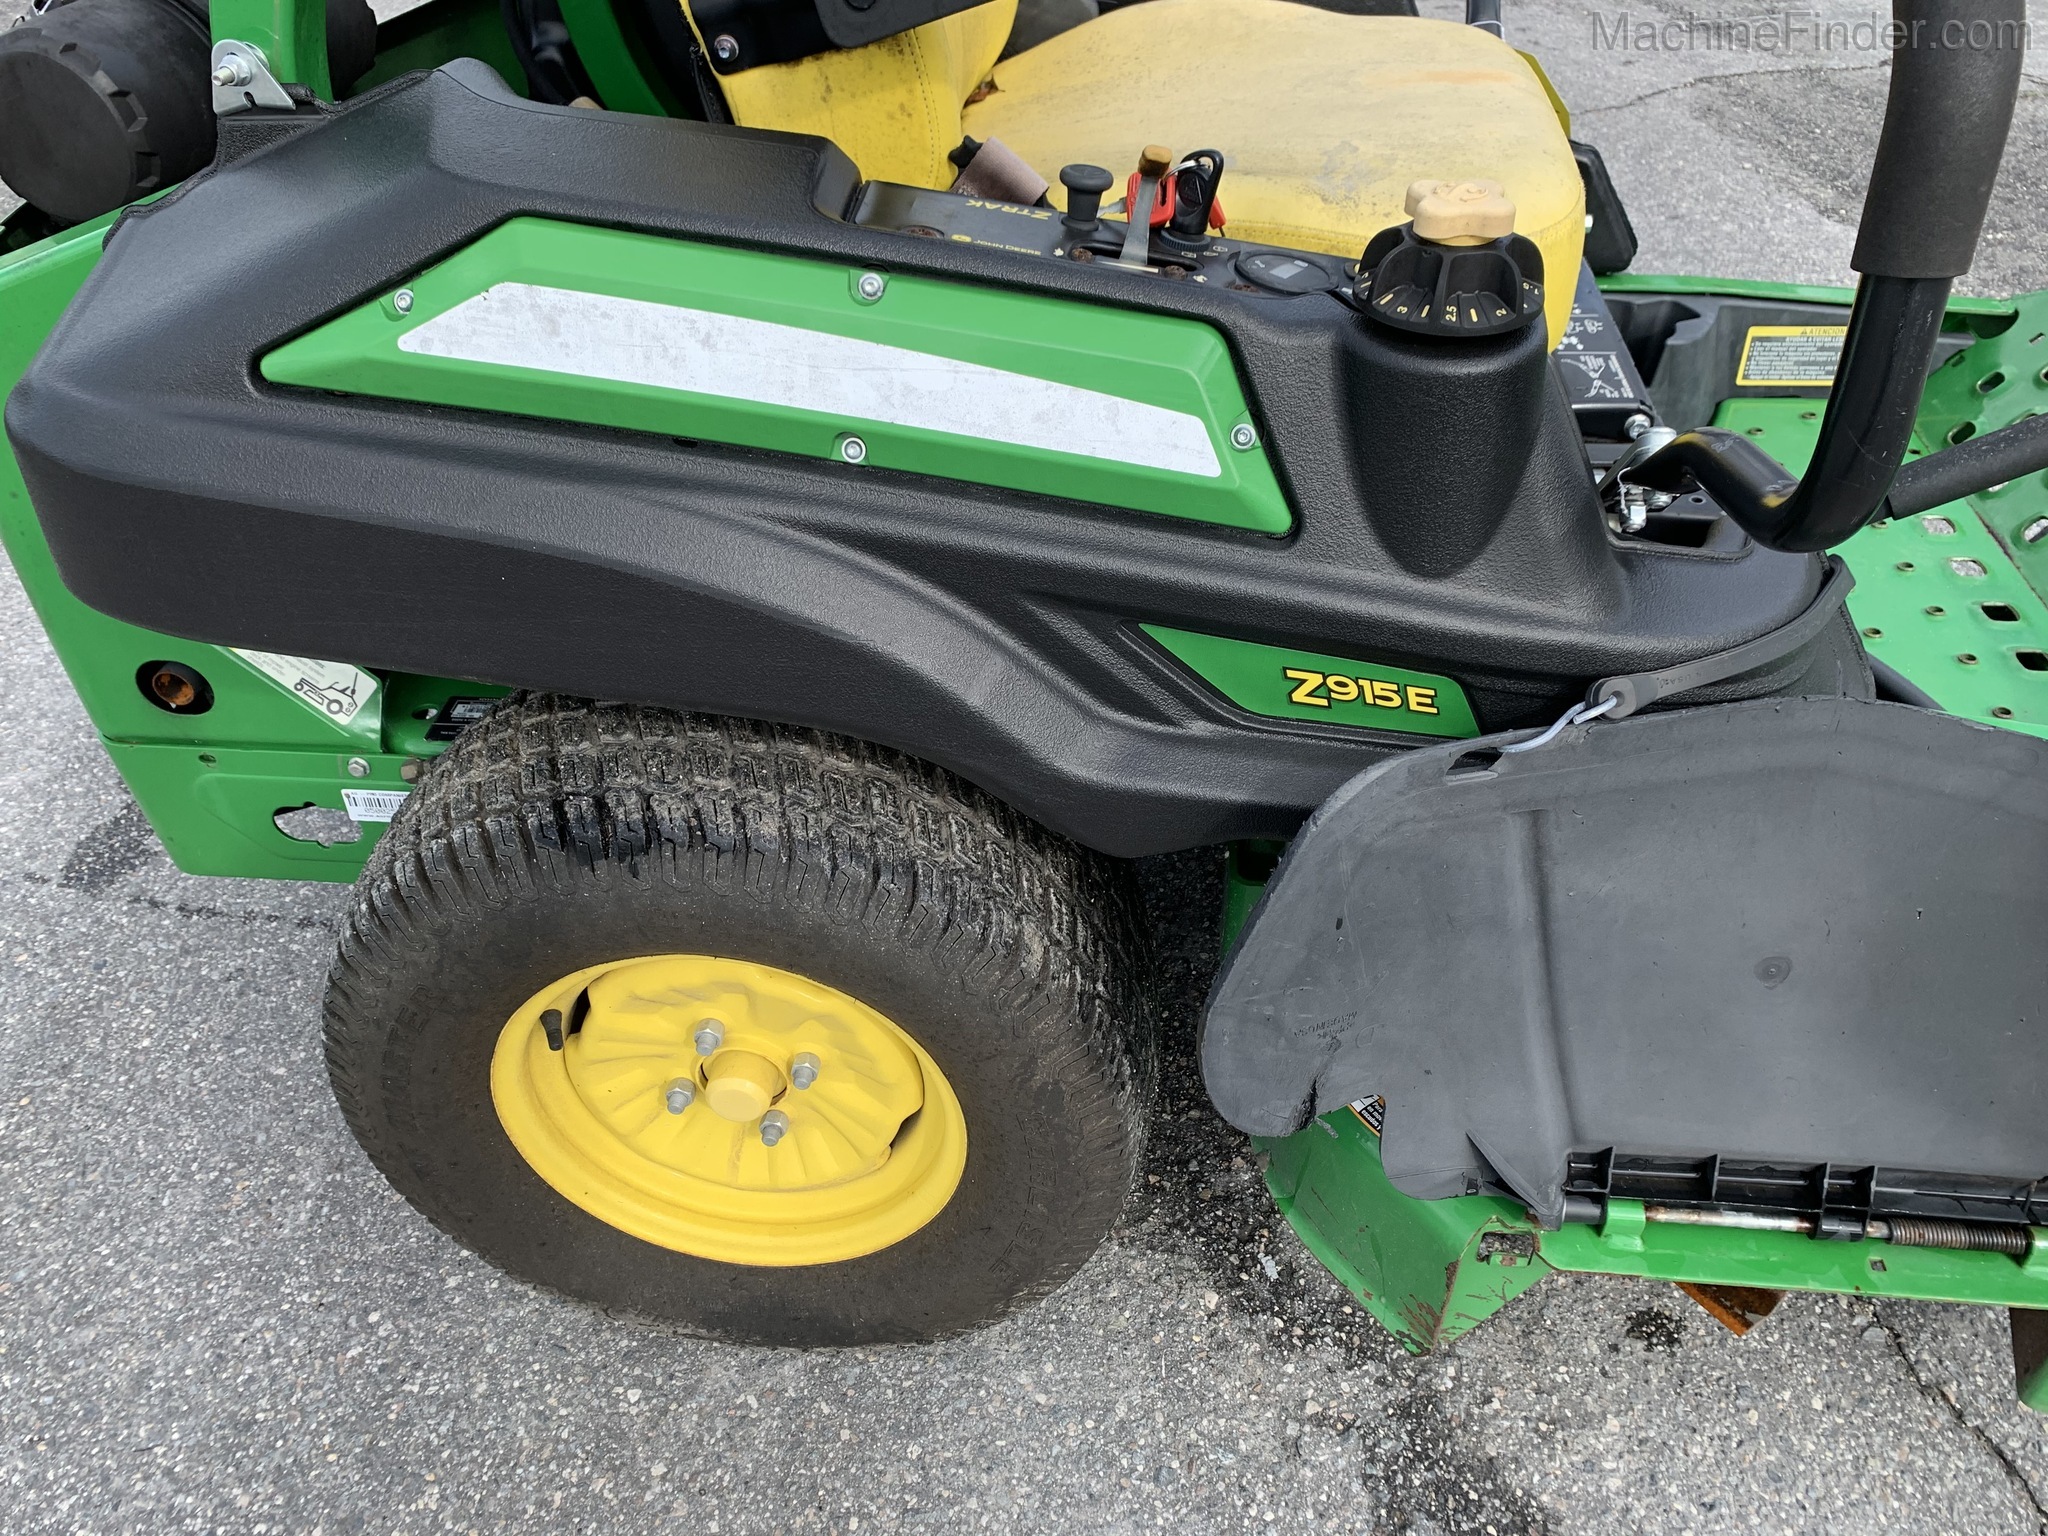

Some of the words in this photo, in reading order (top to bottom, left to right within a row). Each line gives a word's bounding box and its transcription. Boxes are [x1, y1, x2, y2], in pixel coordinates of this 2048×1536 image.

[965, 199, 1052, 220] ZTRAK
[974, 239, 1003, 249] JOHN
[1005, 244, 1041, 256] DEERE
[1397, 306, 1408, 314] 3
[1445, 305, 1457, 321] 2.5
[1496, 308, 1507, 317] 2
